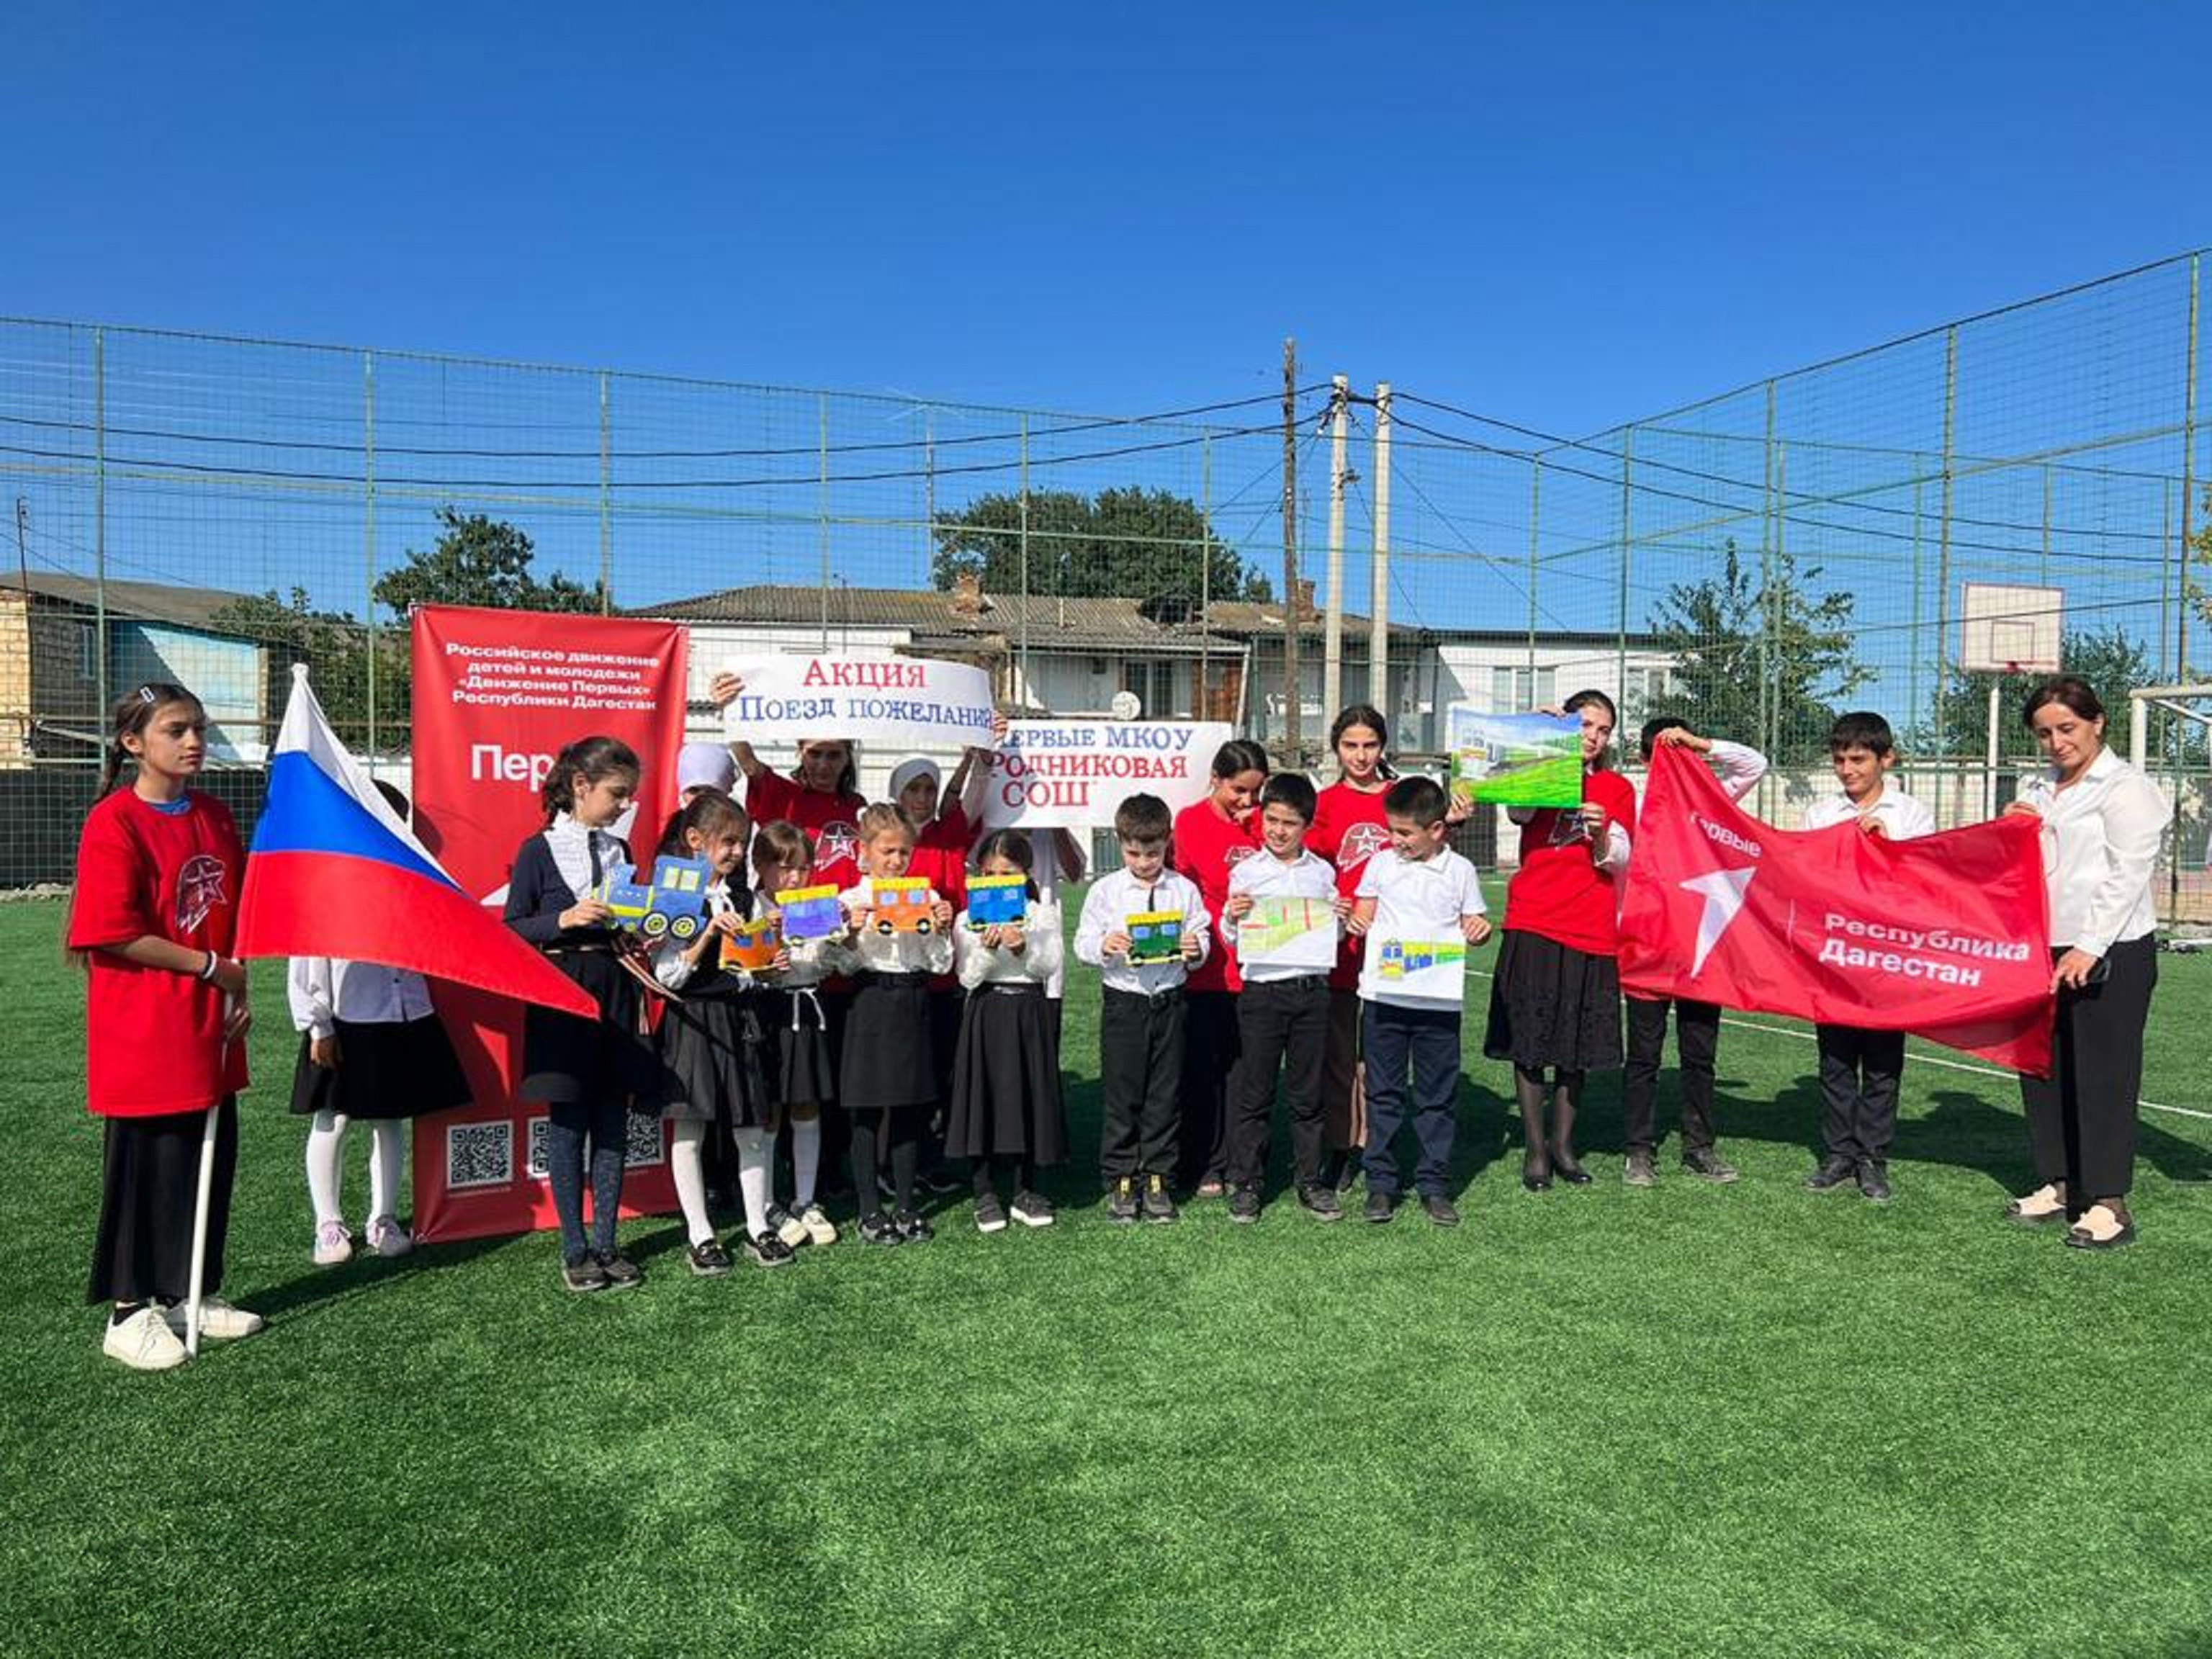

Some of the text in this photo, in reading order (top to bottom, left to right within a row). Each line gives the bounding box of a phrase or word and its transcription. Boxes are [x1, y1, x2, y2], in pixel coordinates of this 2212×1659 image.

[446, 642, 660, 667] Российское движение
[467, 661, 641, 680] детей и молодежи
[452, 690, 656, 710] Республики Дагестан
[1000, 726, 1194, 750] ЕРВЫЕ МКОУ
[471, 744, 556, 793] Пер
[1002, 780, 1089, 808] СОШ
[1824, 912, 2031, 961] Республика
[1818, 938, 1982, 987] Дагестан
